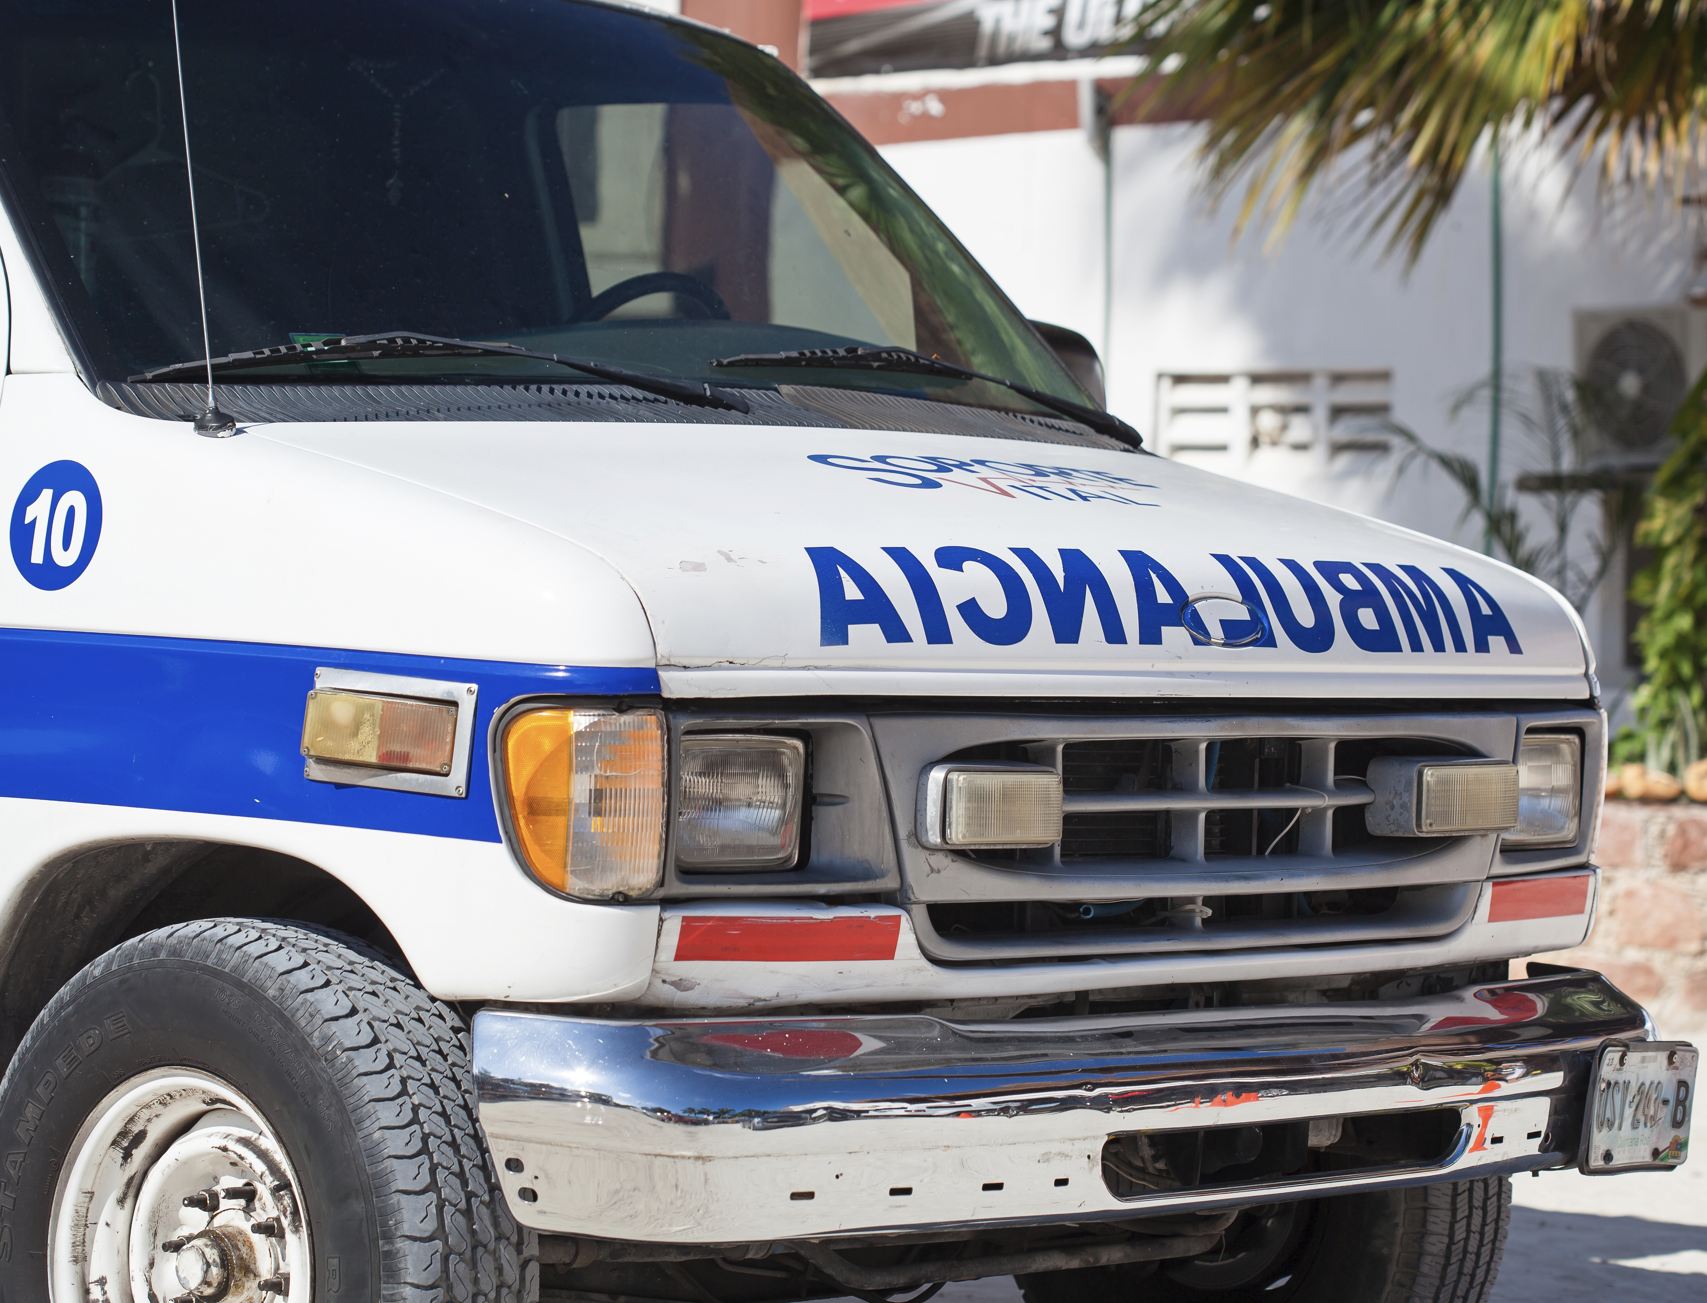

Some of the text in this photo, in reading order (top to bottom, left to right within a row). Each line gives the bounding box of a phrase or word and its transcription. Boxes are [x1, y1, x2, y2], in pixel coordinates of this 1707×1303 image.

[807, 454, 1160, 489] SOPORTE
[936, 476, 1161, 507] VITAL
[24, 488, 88, 568] 10
[0, 1010, 132, 1264] STAMPEDE
